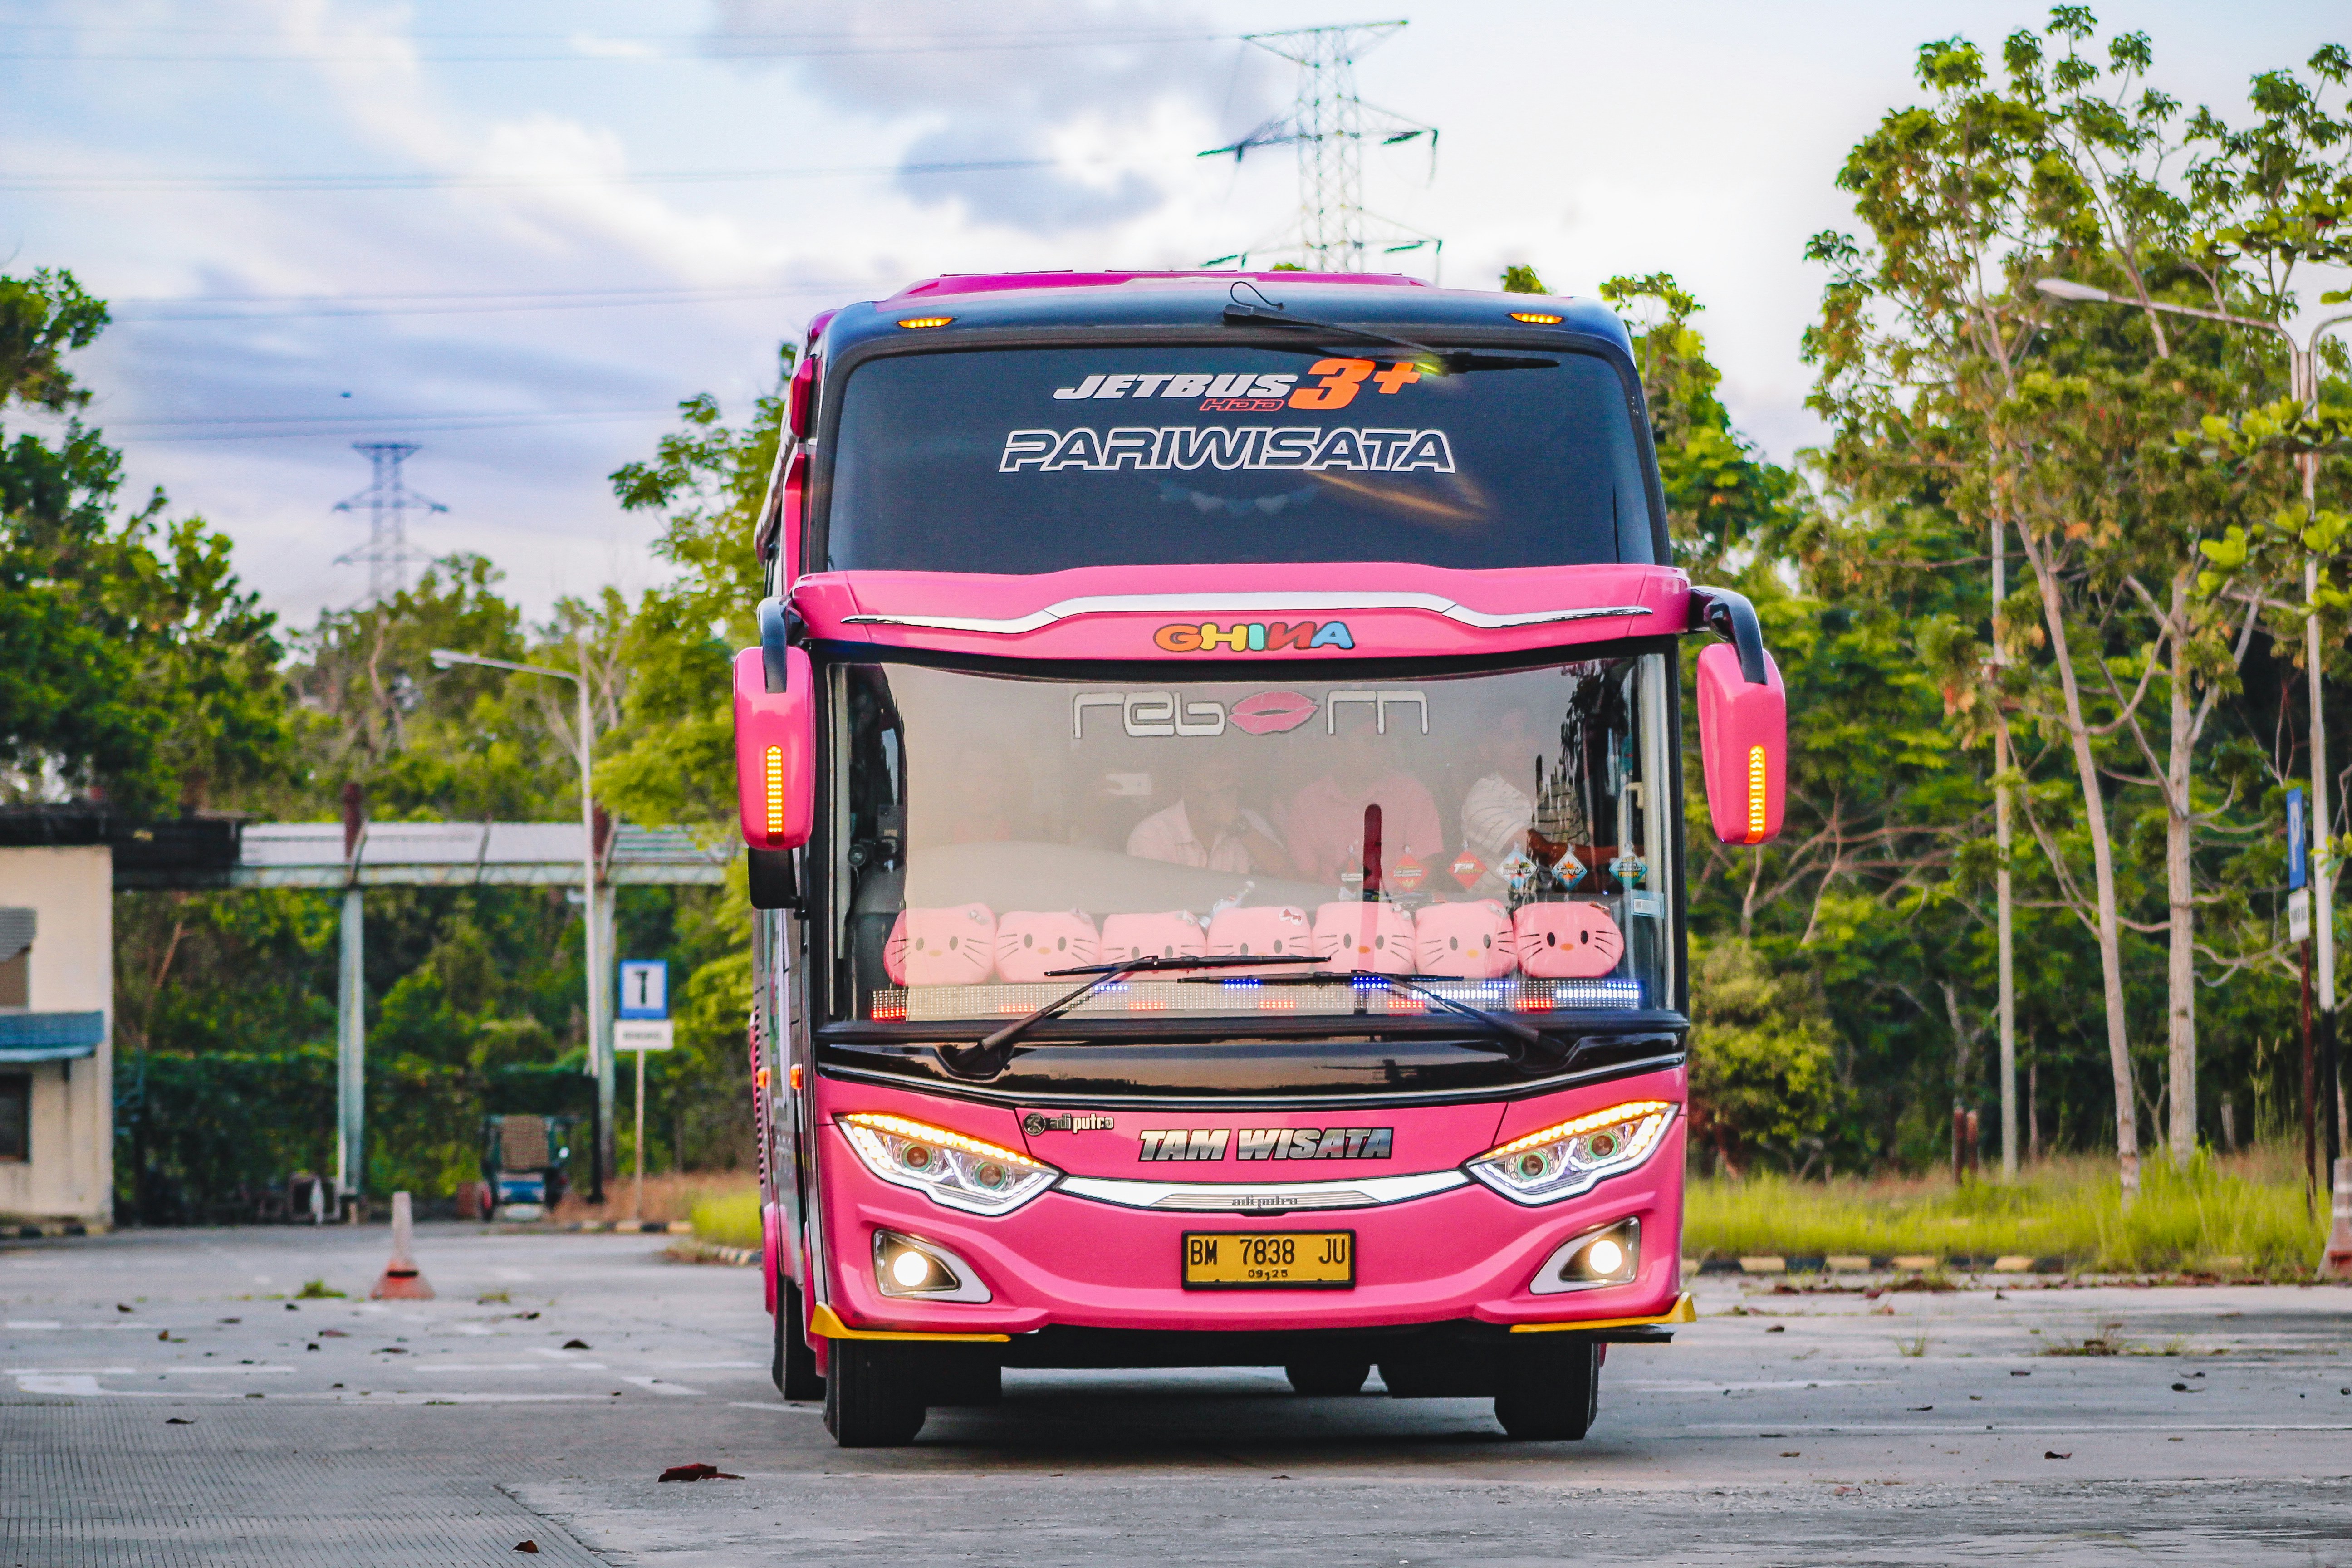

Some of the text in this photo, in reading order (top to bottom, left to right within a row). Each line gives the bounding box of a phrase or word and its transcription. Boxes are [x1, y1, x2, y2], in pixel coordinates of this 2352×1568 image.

[1053, 373, 1298, 400] JETBUS
[1199, 398, 1284, 412] HDD
[999, 426, 1455, 473] PARIWISATA
[1153, 621, 1355, 652] GHINA
[2289, 802, 2300, 872] P
[1138, 1127, 1394, 1162] TAM WISATA
[1190, 1238, 1346, 1265] BM 7838 JU
